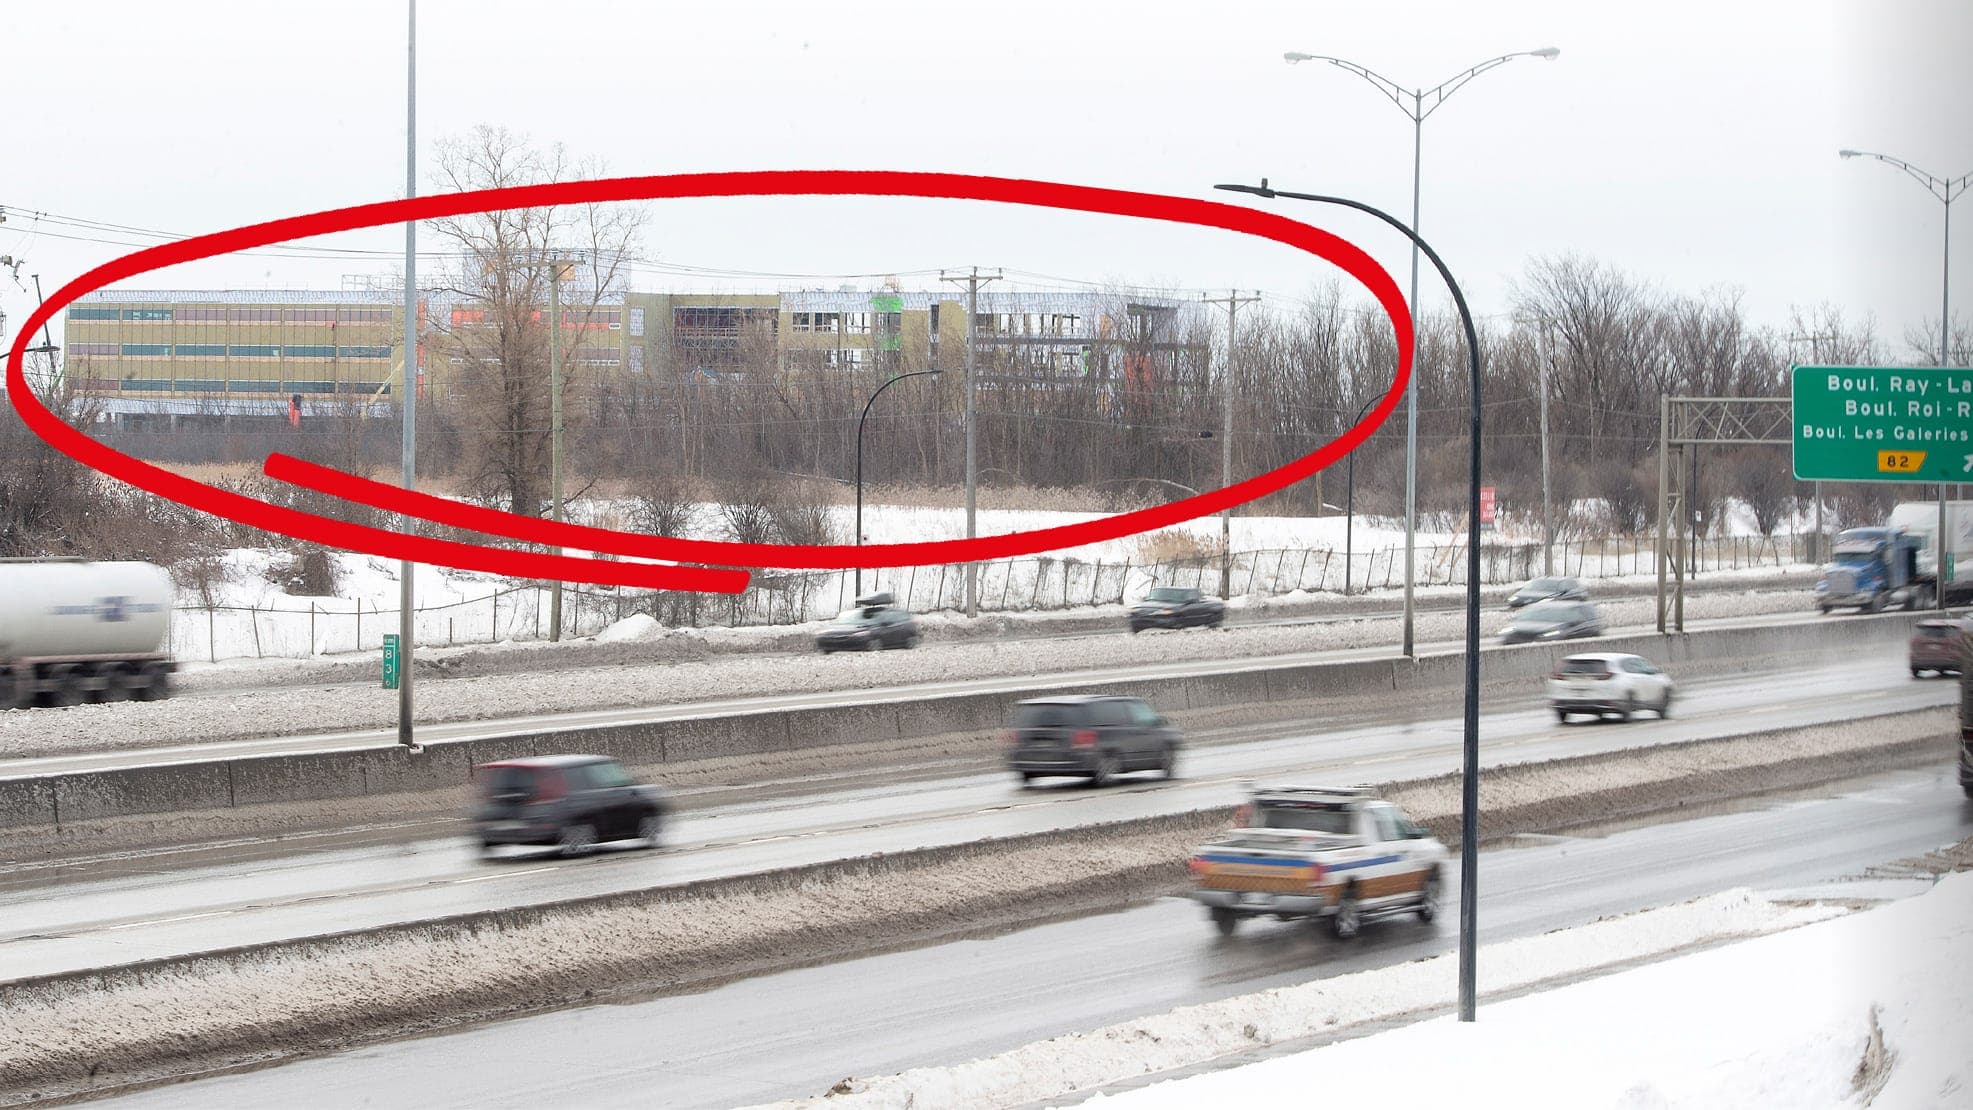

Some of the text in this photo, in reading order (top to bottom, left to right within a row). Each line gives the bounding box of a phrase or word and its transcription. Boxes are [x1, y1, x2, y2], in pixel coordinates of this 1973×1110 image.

[1827, 374, 1879, 392] Boul.
[1845, 399, 1897, 417] Boul.
[1803, 424, 1969, 442] Boul. Les Galeries
[1887, 455, 1909, 468] 82
